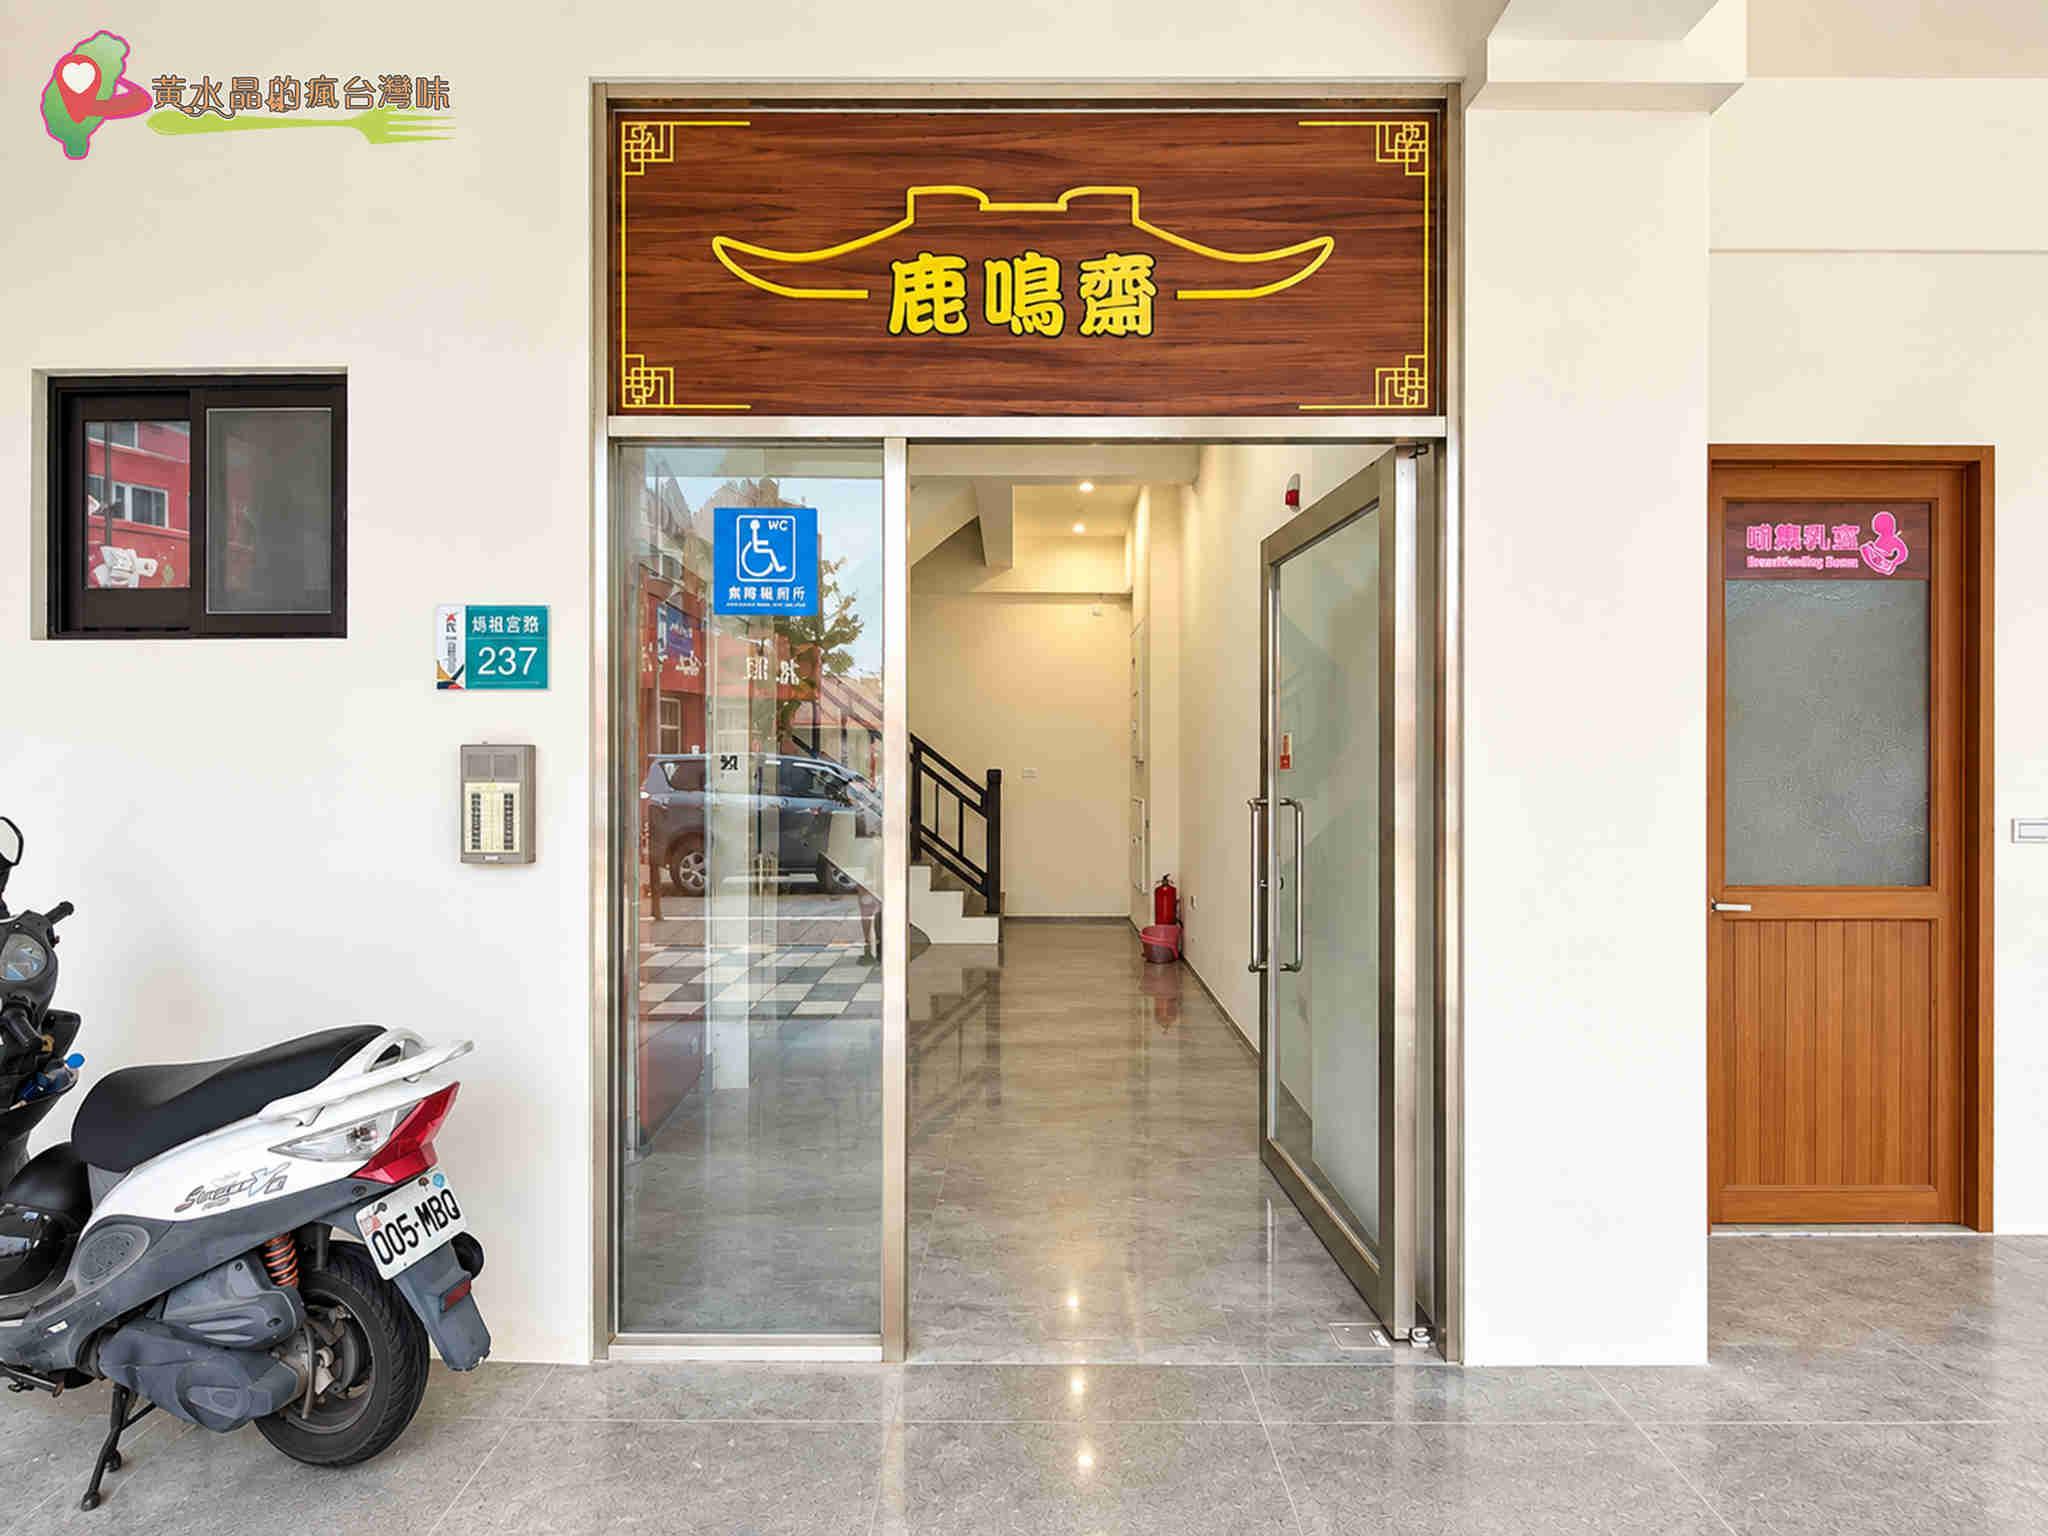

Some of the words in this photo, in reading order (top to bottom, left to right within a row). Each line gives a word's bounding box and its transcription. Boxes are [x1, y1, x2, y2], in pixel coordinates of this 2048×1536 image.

[888, 249, 1158, 337] 鹿鳴齋
[767, 519, 789, 531] WC
[1745, 523, 1861, 551] 哺集乳室
[472, 615, 539, 633] 媽祖宮路
[478, 645, 538, 676] 237
